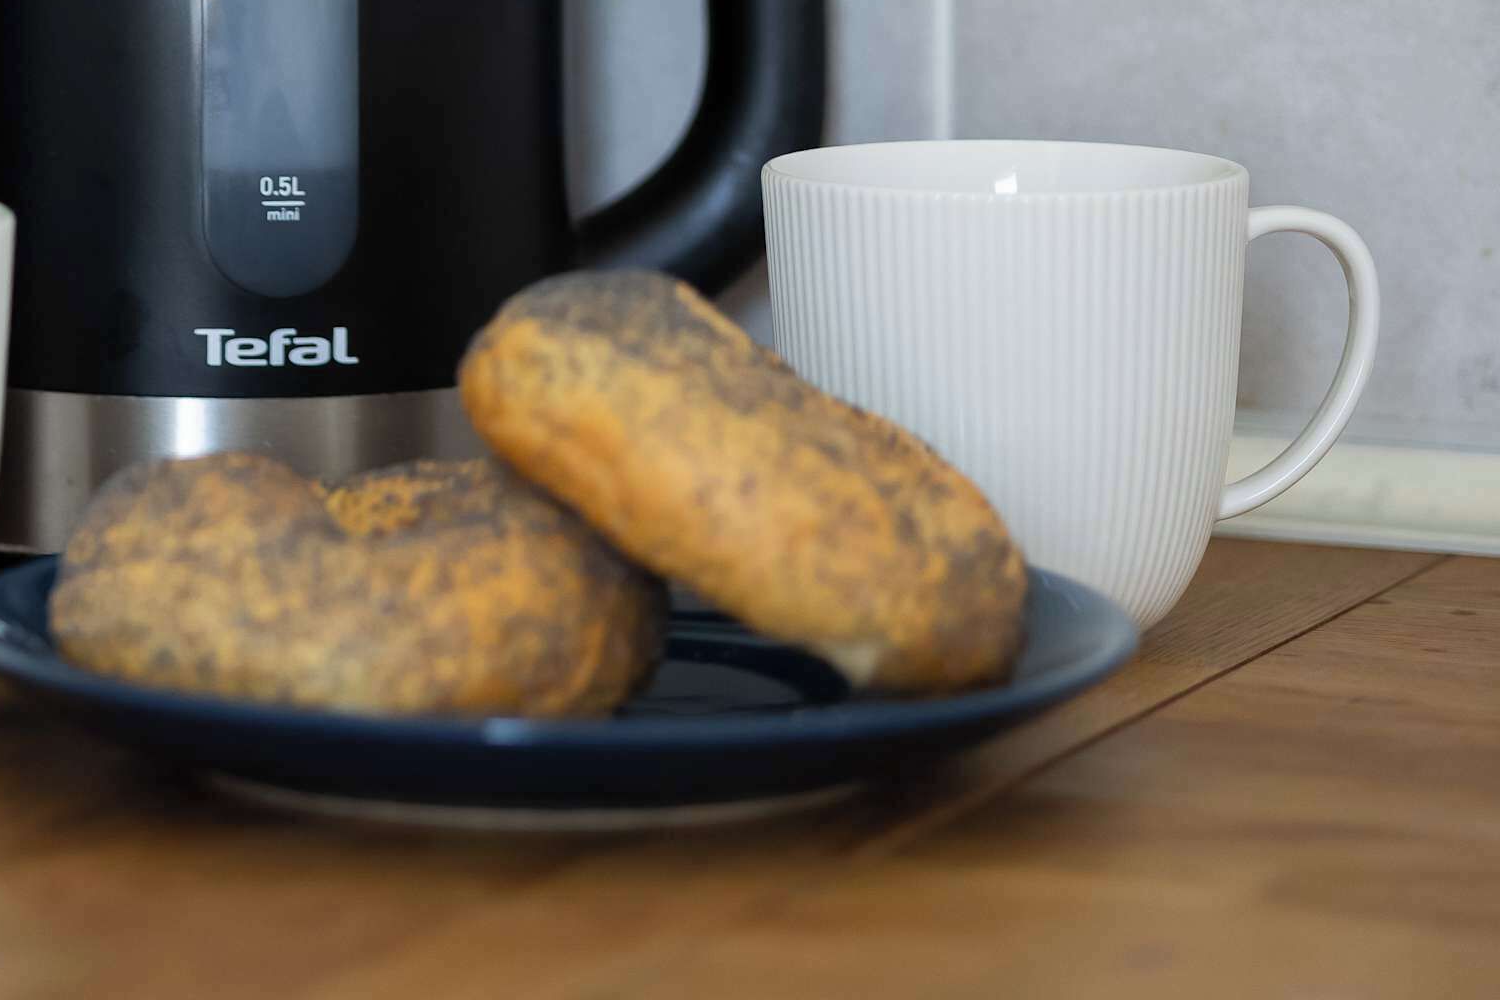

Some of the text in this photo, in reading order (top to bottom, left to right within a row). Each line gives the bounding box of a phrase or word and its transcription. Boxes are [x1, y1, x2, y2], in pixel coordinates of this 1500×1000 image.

[260, 176, 306, 196] 0.5L
[266, 207, 300, 221] mini
[194, 326, 359, 366] Tefal
